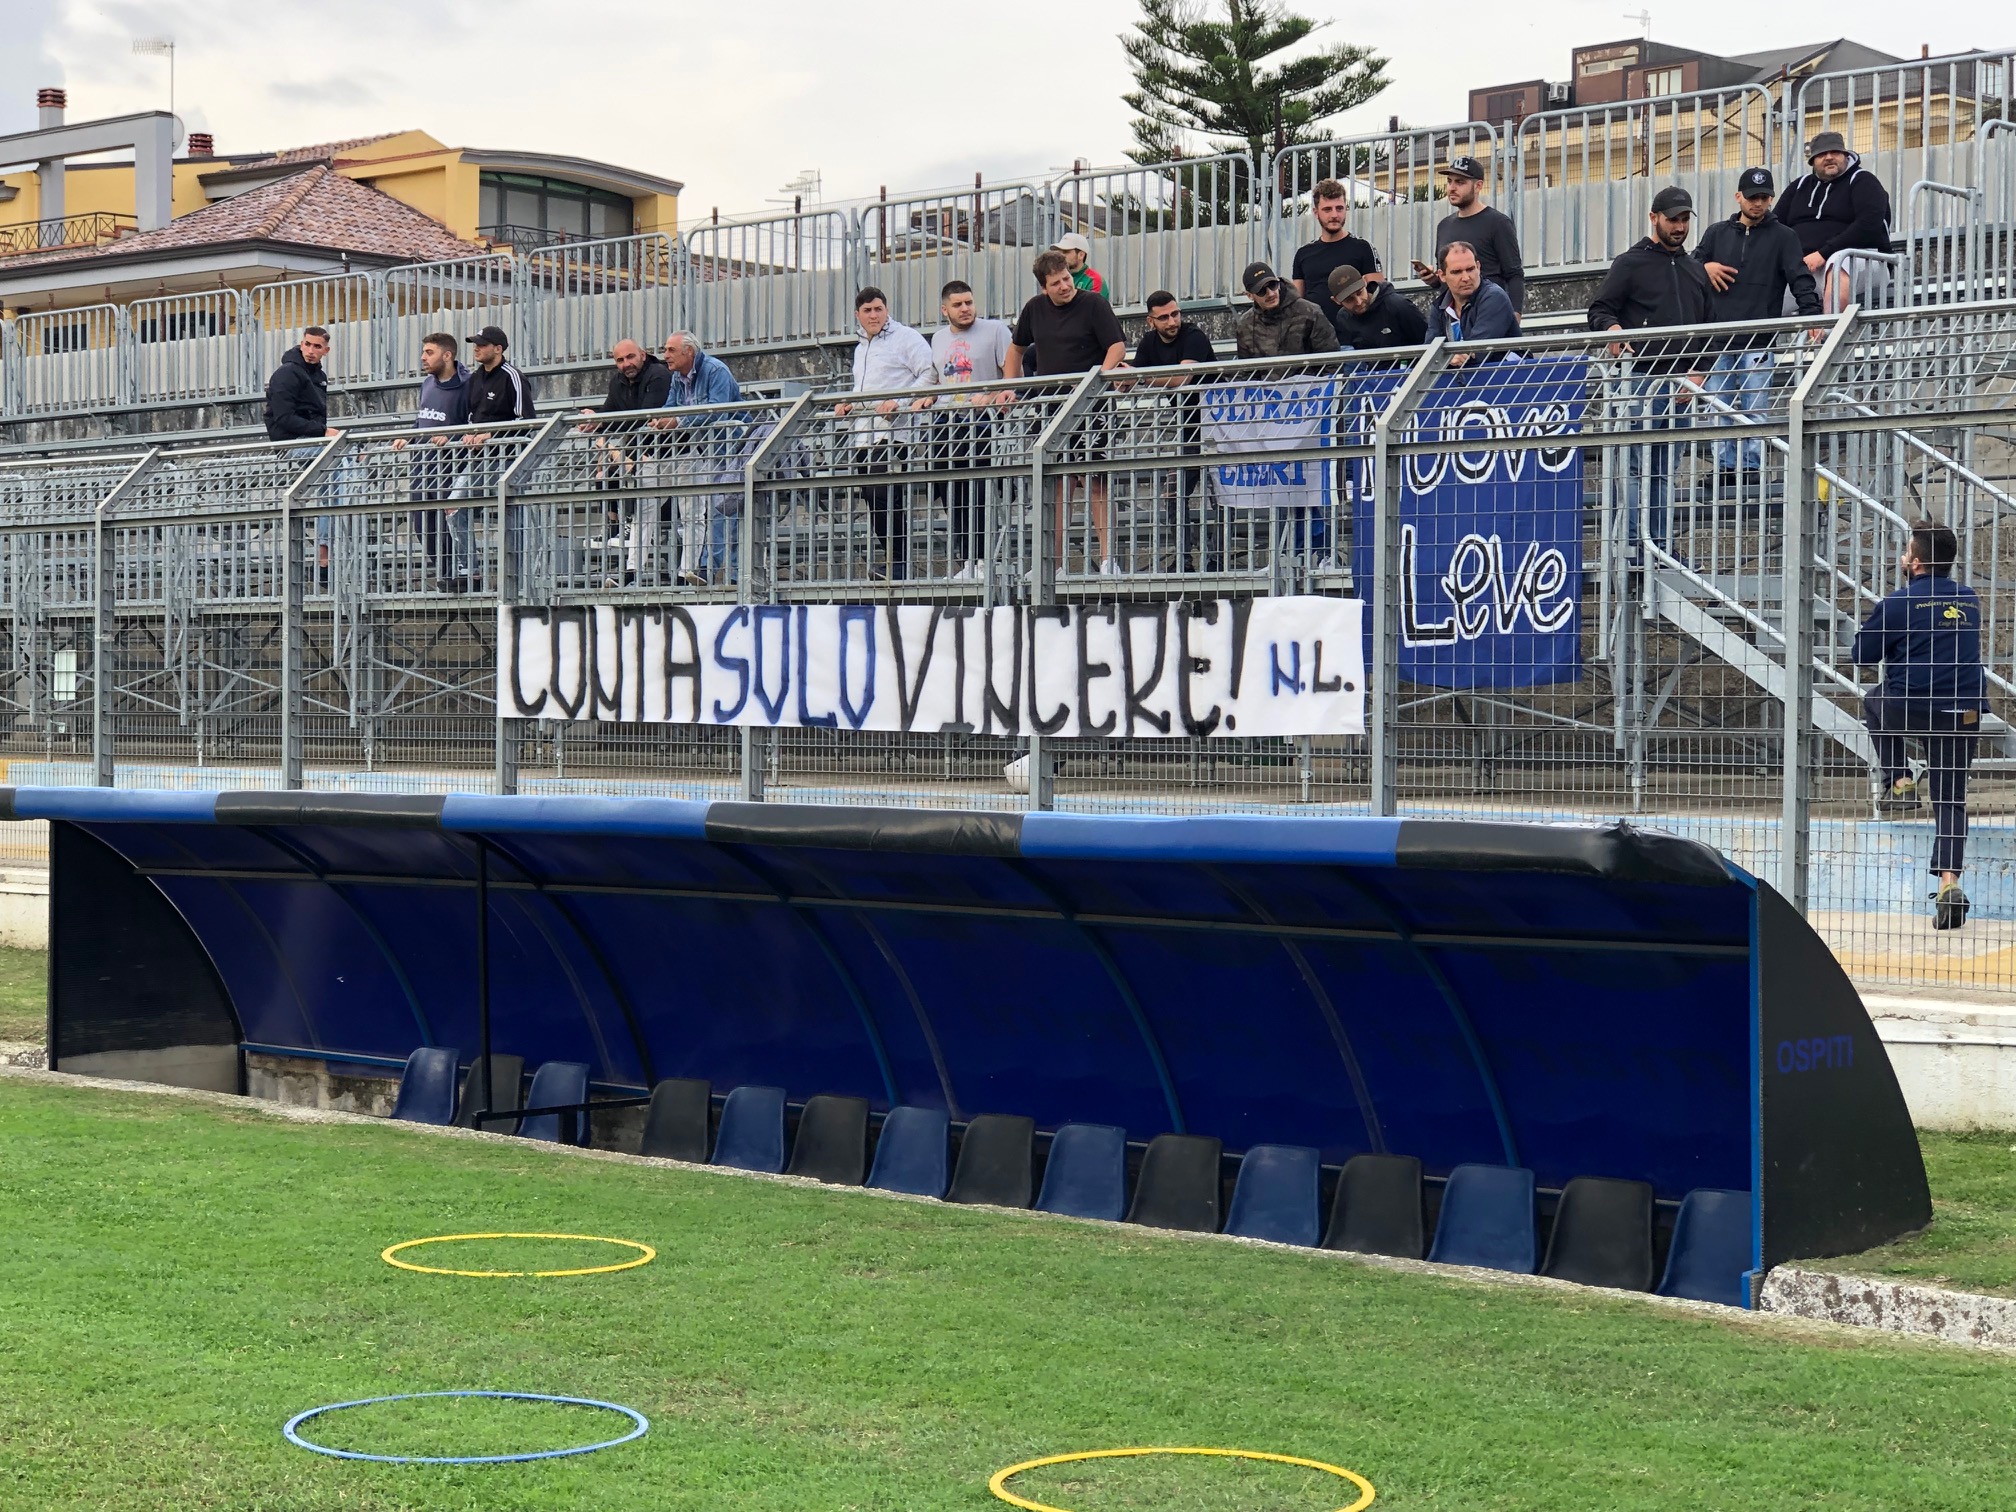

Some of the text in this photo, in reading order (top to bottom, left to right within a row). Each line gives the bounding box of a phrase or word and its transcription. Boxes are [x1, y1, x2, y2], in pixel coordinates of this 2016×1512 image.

[1205, 386, 1322, 425] ULTRAS
[1400, 524, 1574, 648] Leve
[1776, 1035, 1854, 1073] OSPITI
